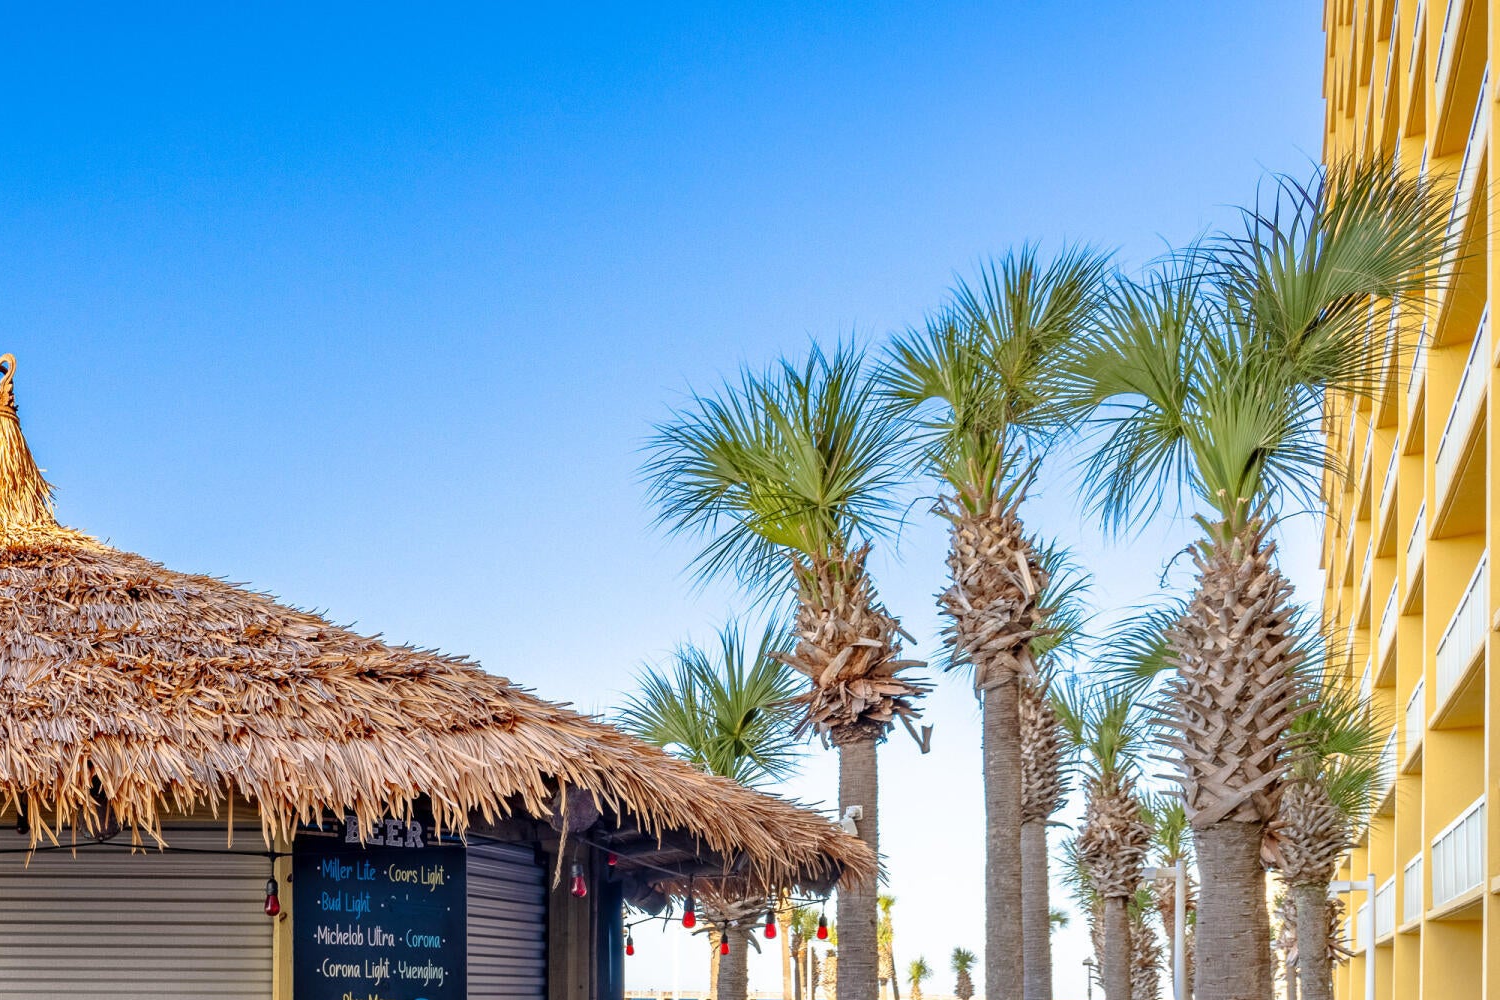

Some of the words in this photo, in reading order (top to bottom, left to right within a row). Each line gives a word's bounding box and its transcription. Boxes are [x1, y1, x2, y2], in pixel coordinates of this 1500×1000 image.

[322, 858, 353, 881] Miller
[357, 860, 376, 881] Lite
[389, 864, 418, 884] Coors
[421, 864, 445, 892] Light
[321, 891, 341, 911] Bud
[345, 890, 371, 920] Light
[317, 923, 364, 946] Michelob
[367, 925, 395, 947] Ultra
[406, 929, 441, 949] Corona
[322, 958, 361, 978] Corona
[365, 957, 390, 986] Light
[398, 959, 444, 987] Yuengling
